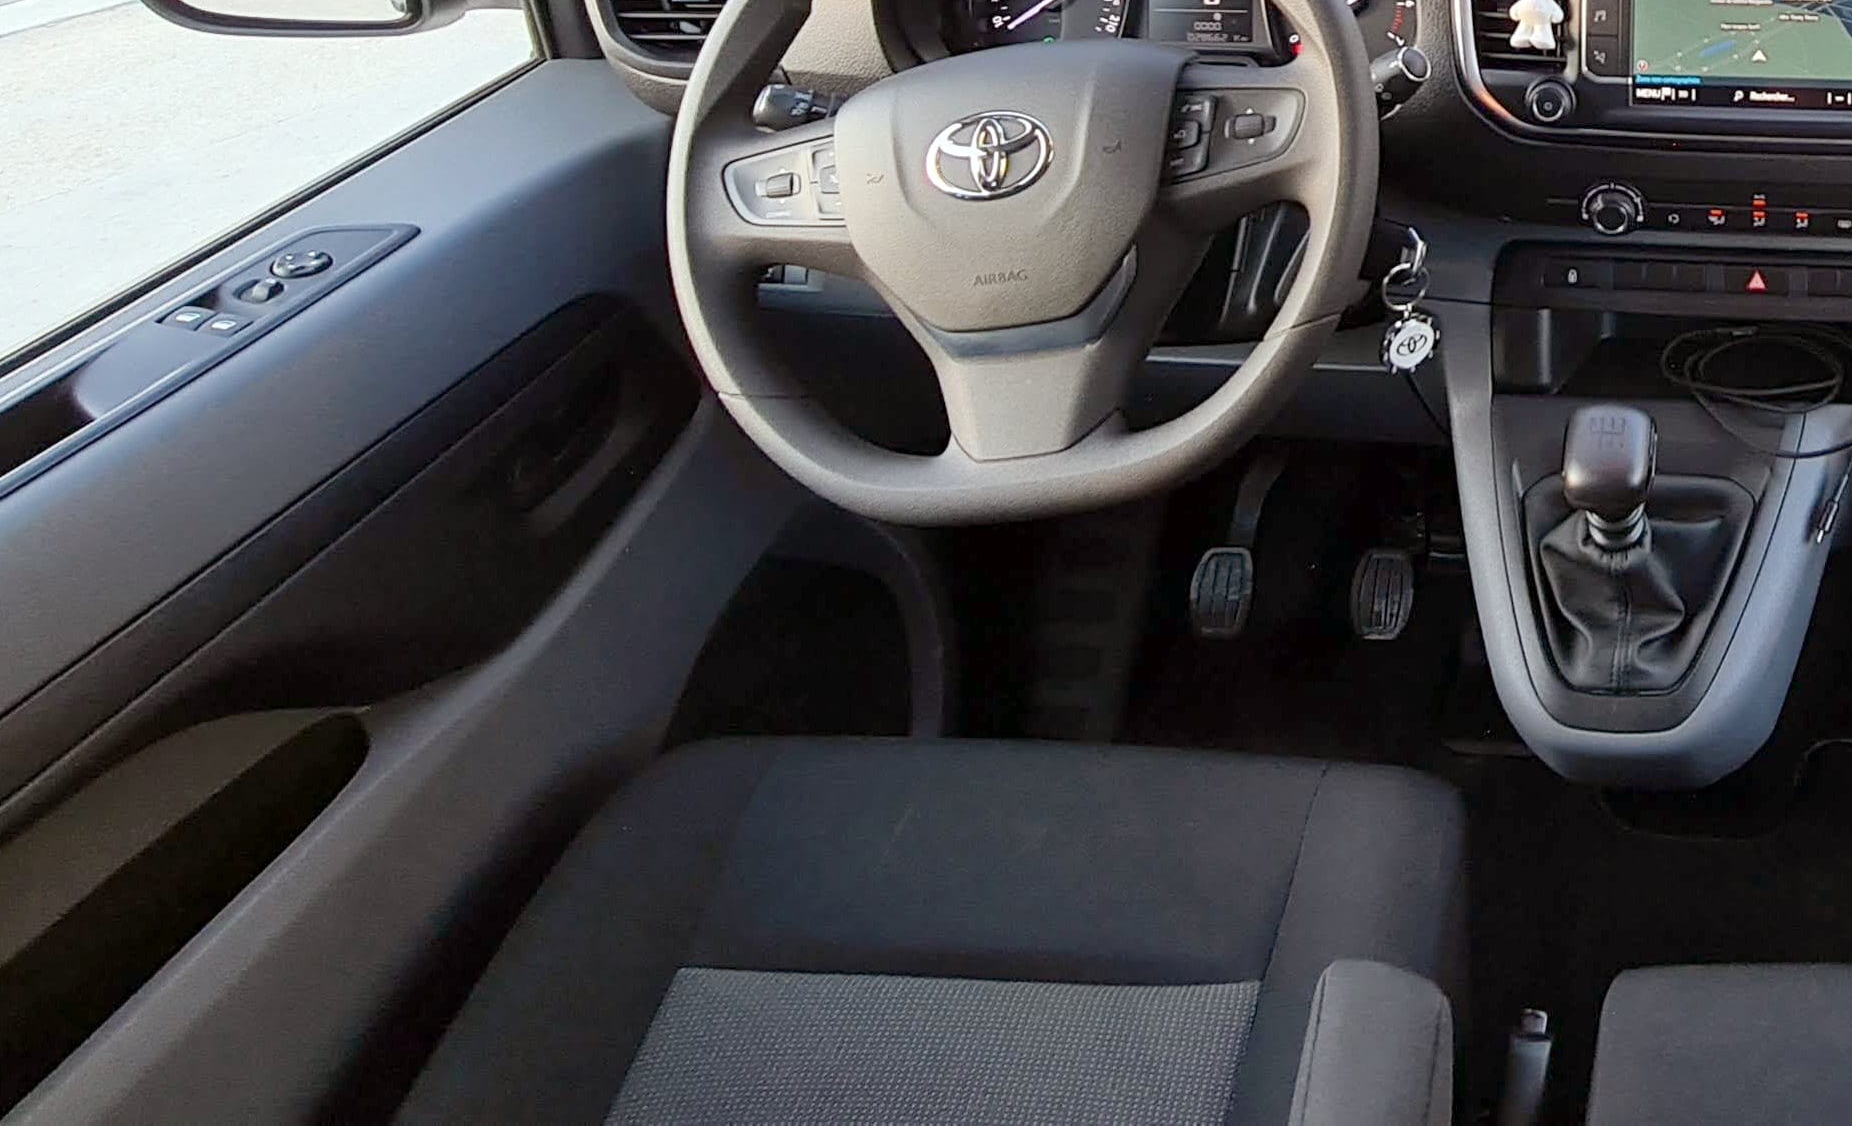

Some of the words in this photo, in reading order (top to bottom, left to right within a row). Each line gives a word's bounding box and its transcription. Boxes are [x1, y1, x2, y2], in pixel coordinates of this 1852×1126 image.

[992, 16, 1004, 28] 10
[1105, 14, 1120, 32] 210
[973, 269, 1028, 286] AIRBAG
